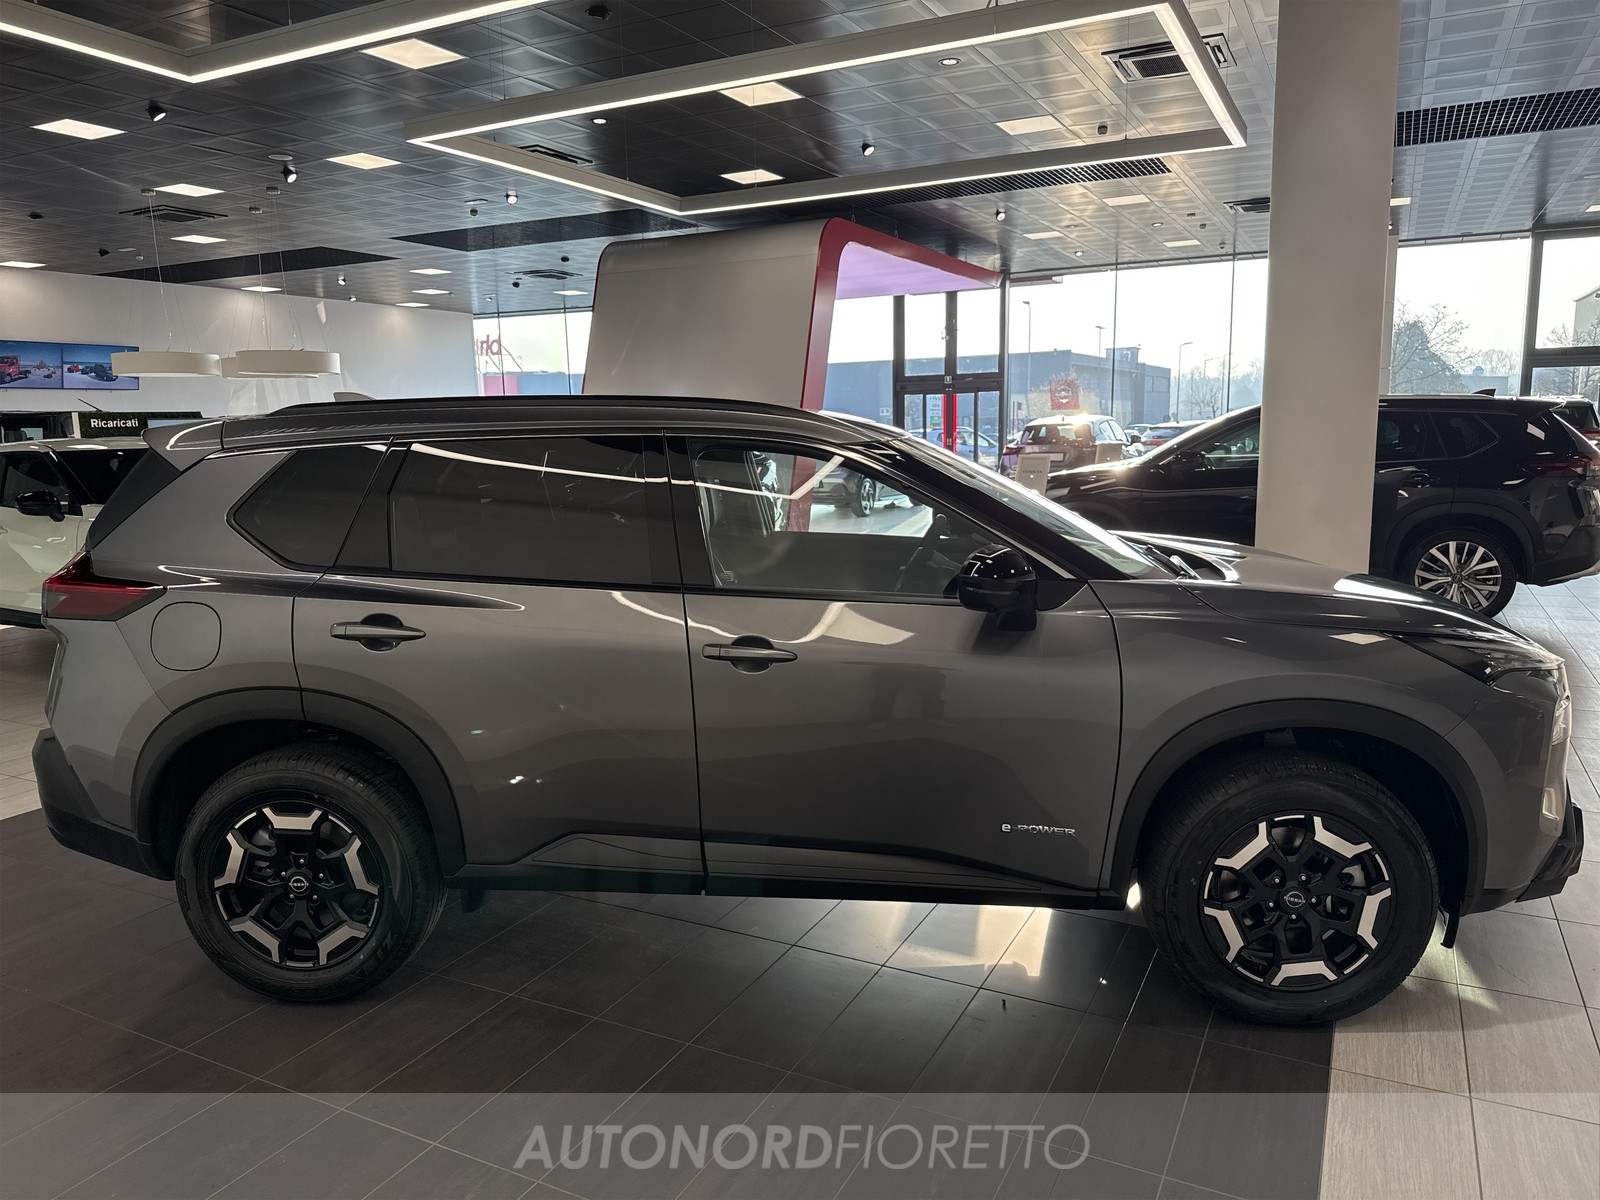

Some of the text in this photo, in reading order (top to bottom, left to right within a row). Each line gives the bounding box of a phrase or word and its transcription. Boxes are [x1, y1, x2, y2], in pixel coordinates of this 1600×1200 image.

[90, 418, 139, 428] Ricaricati
[1001, 823, 1076, 837] e-POWER
[1283, 895, 1306, 904] NISSAN
